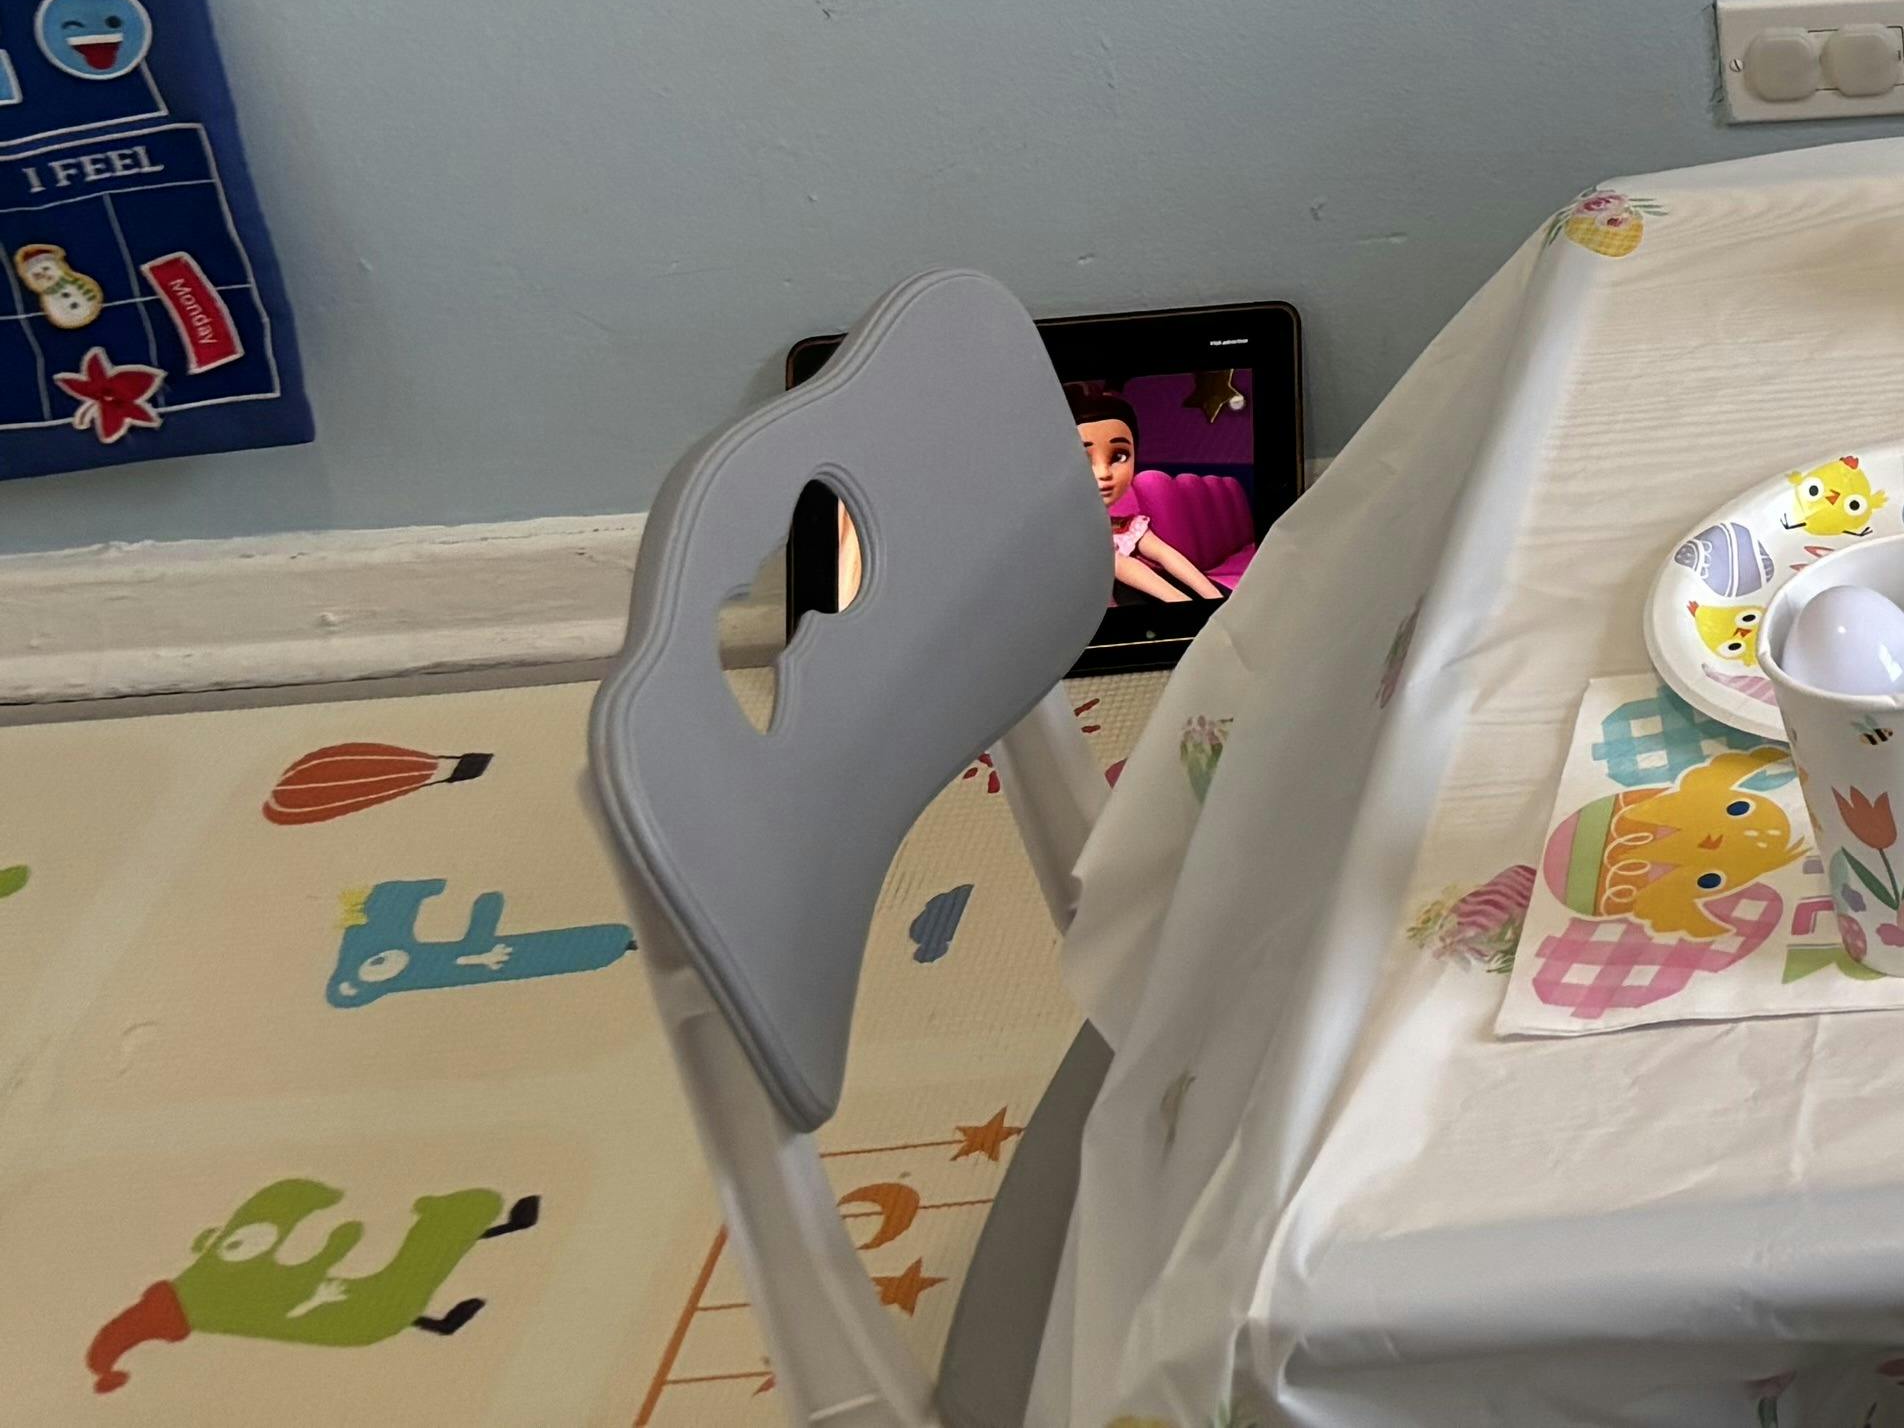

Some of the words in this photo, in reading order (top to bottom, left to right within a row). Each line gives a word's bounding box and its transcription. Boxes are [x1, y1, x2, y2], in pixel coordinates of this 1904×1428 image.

[23, 166, 46, 193] I
[49, 145, 165, 187] FEEL
[168, 277, 217, 345] Monday
